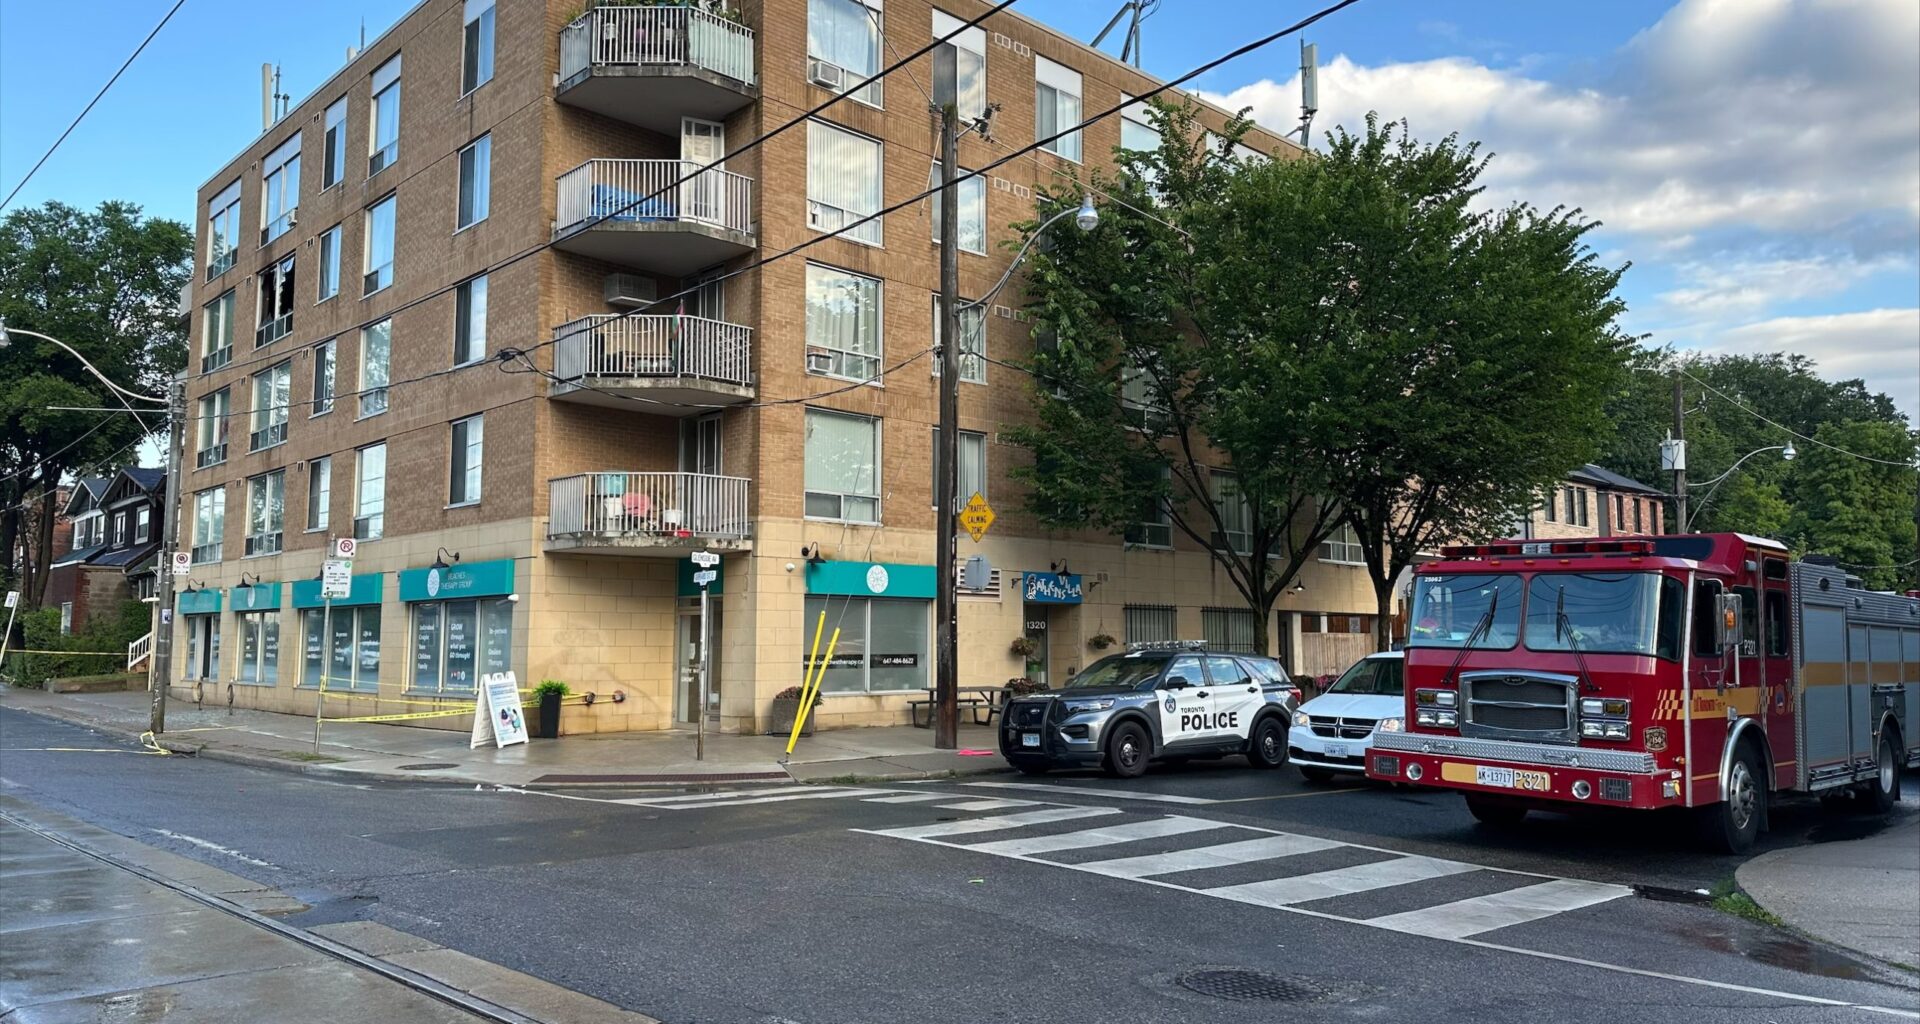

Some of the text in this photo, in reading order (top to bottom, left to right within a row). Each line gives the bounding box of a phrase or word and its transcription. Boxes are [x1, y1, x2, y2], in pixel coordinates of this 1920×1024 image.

[967, 504, 987, 513] TRAFFIC
[967, 515, 988, 524] CALMING
[971, 526, 983, 535] ZONE
[441, 581, 458, 590] THERAPY
[1058, 575, 1082, 597] VILLA
[450, 623, 464, 631] GROW
[1026, 620, 1046, 629] 1320
[1743, 639, 1756, 655] P321
[1181, 712, 1238, 731] POLICE
[1514, 770, 1548, 791] P321
